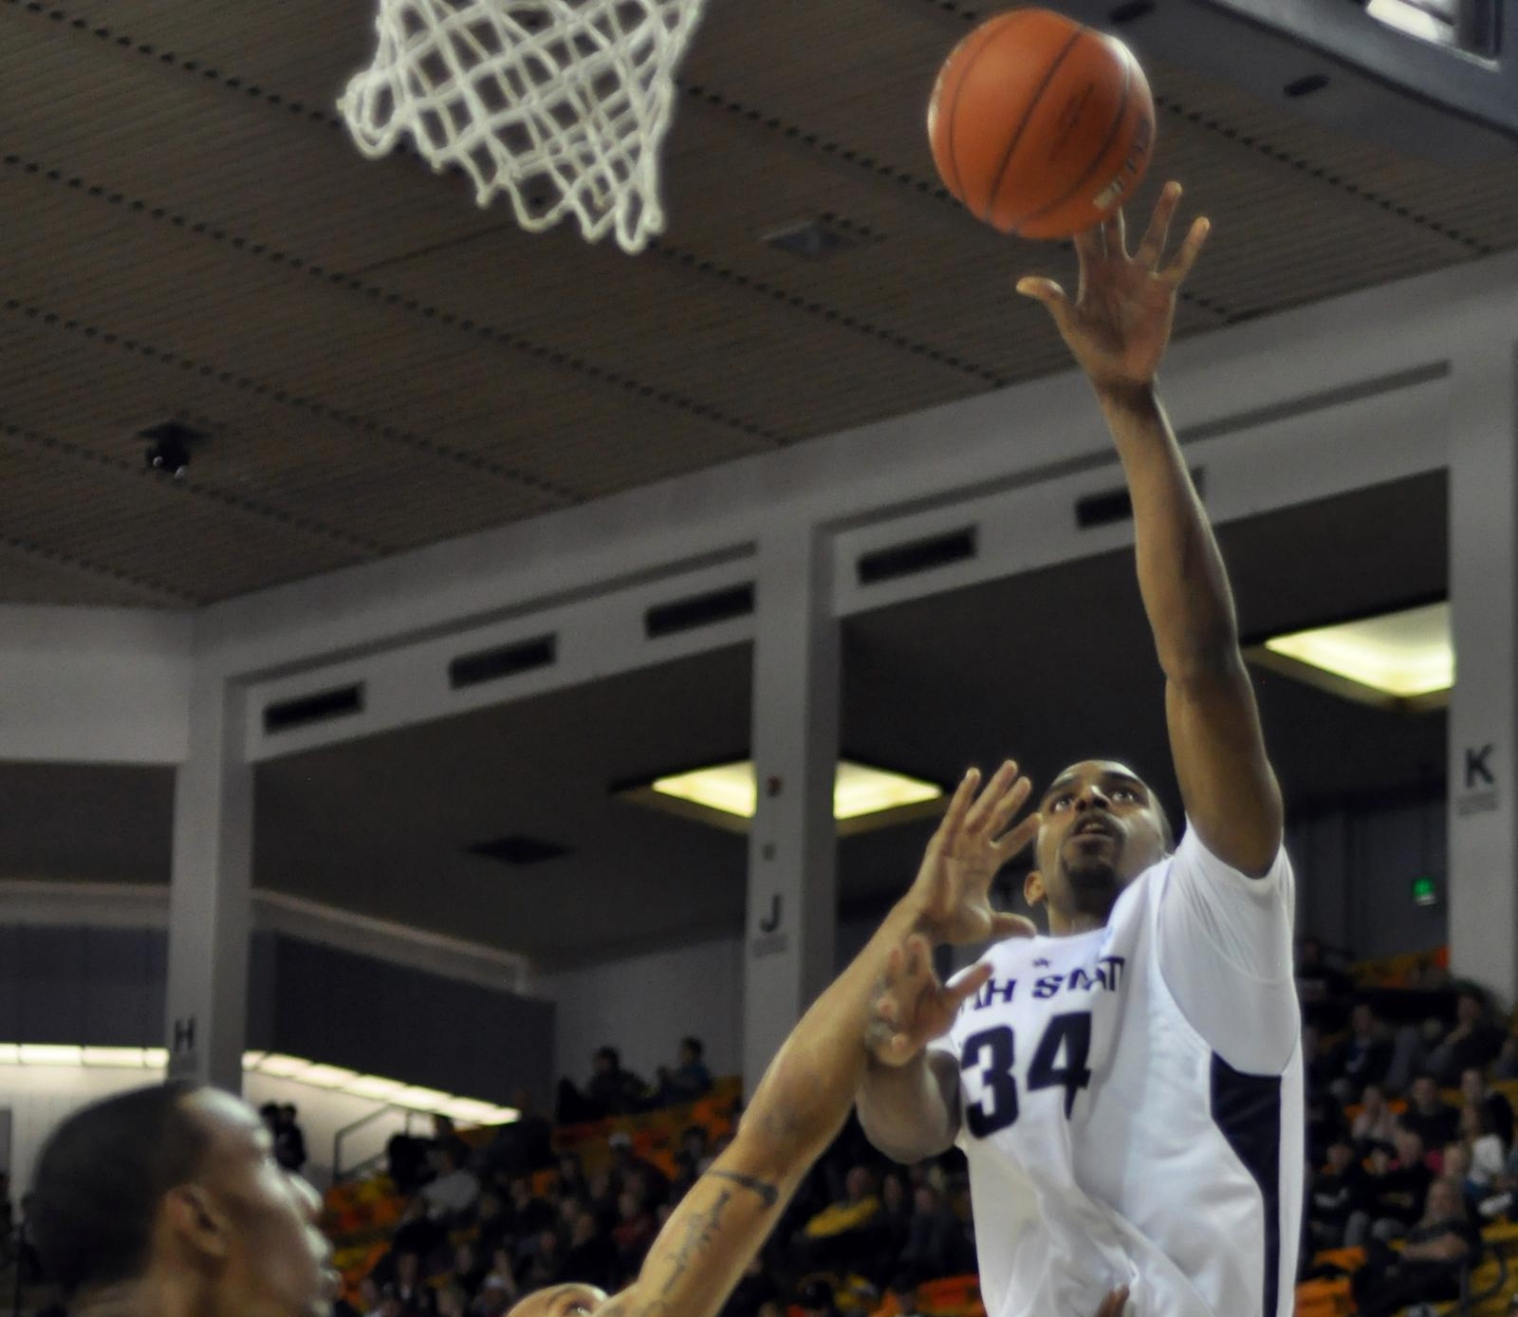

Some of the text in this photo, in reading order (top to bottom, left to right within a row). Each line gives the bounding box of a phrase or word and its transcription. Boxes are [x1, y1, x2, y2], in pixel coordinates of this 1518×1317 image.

[1465, 743, 1494, 788] K
[759, 893, 781, 932] J
[1031, 956, 1126, 999] STAT
[174, 1017, 197, 1053] H
[961, 1010, 1092, 1139] 34
